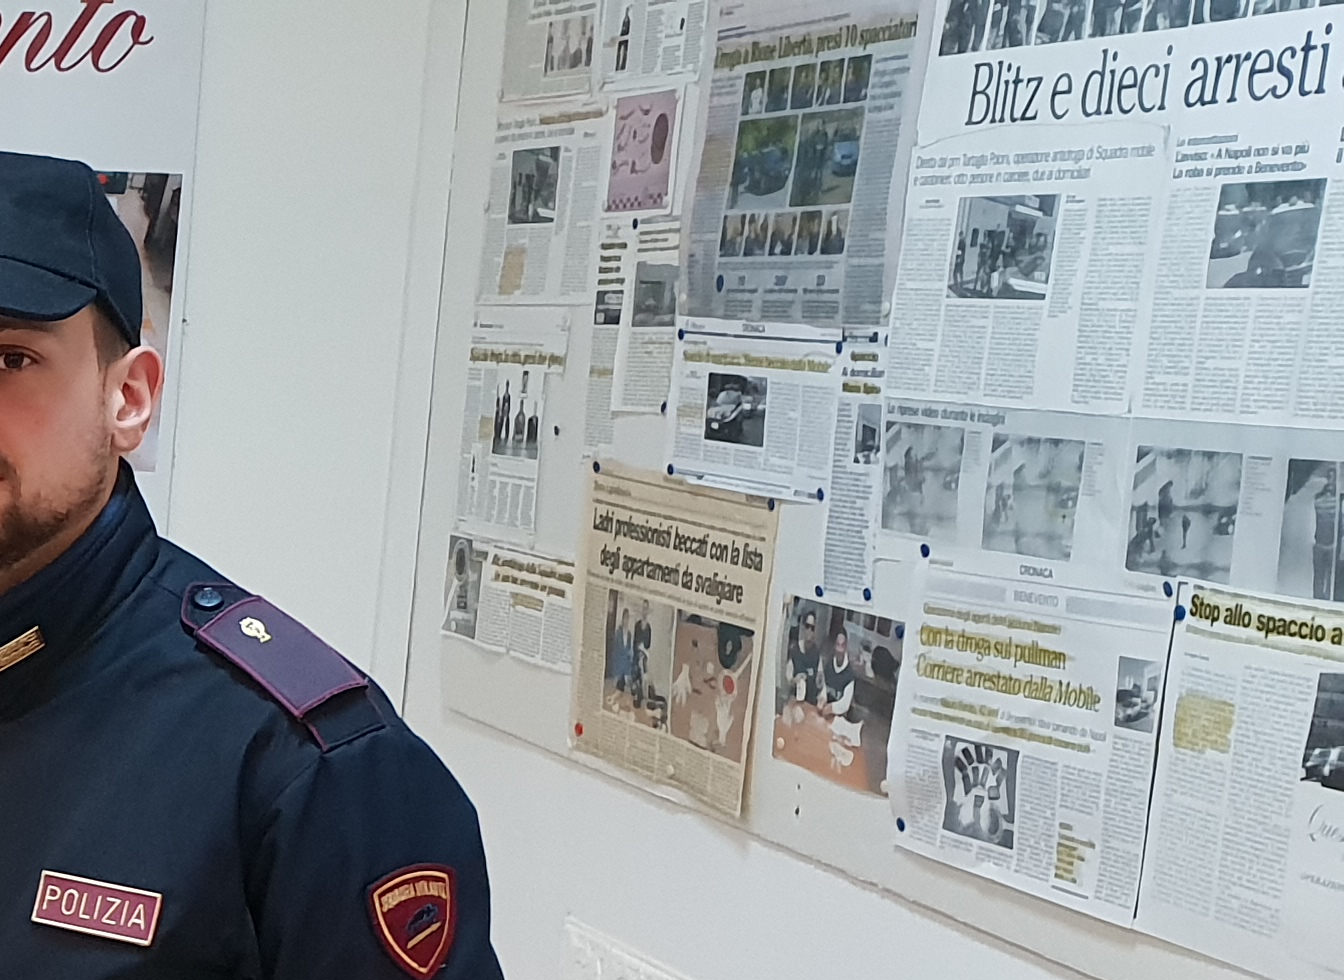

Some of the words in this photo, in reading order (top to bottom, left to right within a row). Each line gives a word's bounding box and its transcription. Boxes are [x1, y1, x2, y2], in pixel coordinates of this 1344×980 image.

[844, 24, 858, 47] 10
[965, 60, 1043, 126] Blitz
[1050, 72, 1072, 120] e
[1080, 44, 1173, 117] dieci
[1183, 23, 1333, 108] arresti
[673, 526, 709, 558] beccati
[710, 541, 728, 563] con
[730, 540, 739, 566] la
[681, 565, 693, 590] da
[1190, 594, 1220, 627] Stop
[1223, 603, 1252, 628] allo
[1256, 616, 1326, 642] spaccio
[1331, 626, 1343, 645] a
[920, 622, 942, 647] Con
[944, 626, 954, 650] la
[956, 629, 991, 662] droga
[994, 637, 1012, 660] sul
[1014, 640, 1066, 670] pullman
[917, 653, 963, 685] Corriere
[965, 668, 1021, 695] arrestato
[1023, 674, 1053, 703] dalla
[1054, 679, 1101, 713] Mobile
[42, 884, 145, 931] POLIZIA
